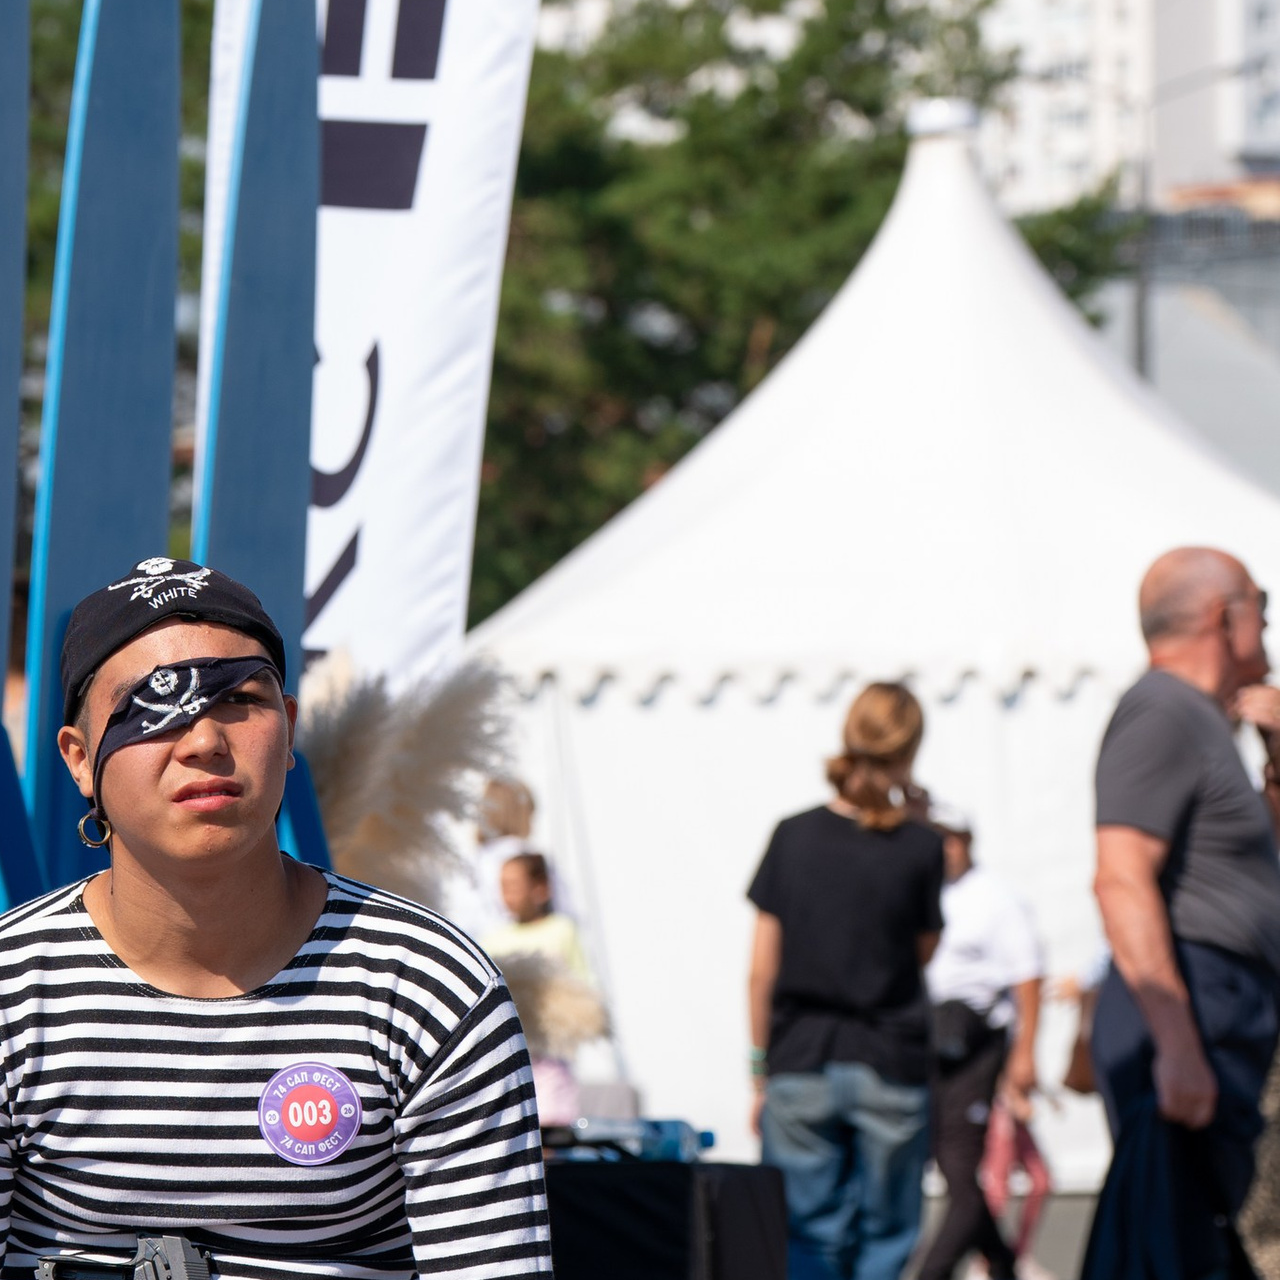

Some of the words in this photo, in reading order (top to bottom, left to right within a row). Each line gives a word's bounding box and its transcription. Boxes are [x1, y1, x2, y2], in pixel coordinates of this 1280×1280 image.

[148, 587, 197, 609] WHITE
[273, 1084, 287, 1099] 74
[286, 1071, 308, 1087] САП
[312, 1072, 341, 1092] ФЕСТ
[288, 1099, 332, 1127] 003
[280, 1135, 294, 1149] 74
[294, 1143, 315, 1155] САП
[318, 1131, 343, 1152] ФЕСТ
